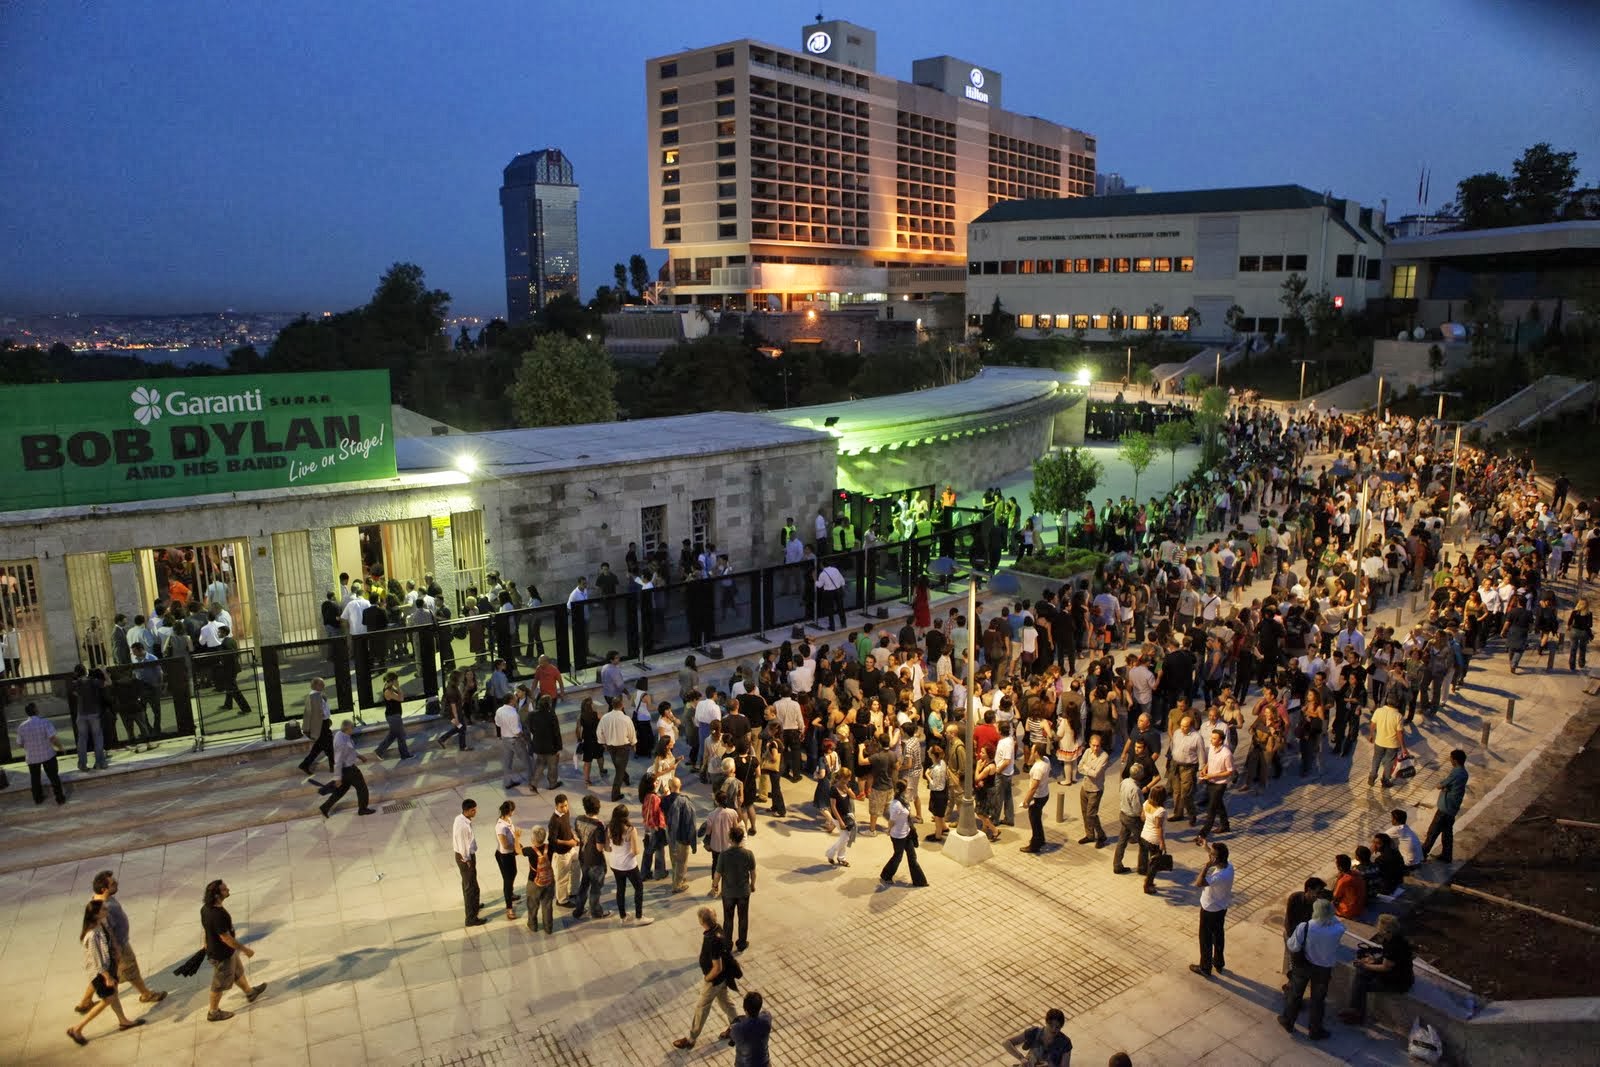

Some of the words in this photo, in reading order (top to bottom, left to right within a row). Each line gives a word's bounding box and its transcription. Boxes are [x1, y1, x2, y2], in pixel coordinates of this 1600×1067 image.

[965, 85, 989, 103] Hilton
[165, 387, 263, 416] Garanti
[21, 428, 153, 471] BOB
[171, 415, 361, 460] DYLAN
[289, 459, 318, 481] Live
[322, 454, 335, 467] on
[339, 424, 384, 461] Stage!
[126, 463, 175, 480] AND
[184, 462, 219, 475] HIS
[227, 456, 287, 472] BAND
